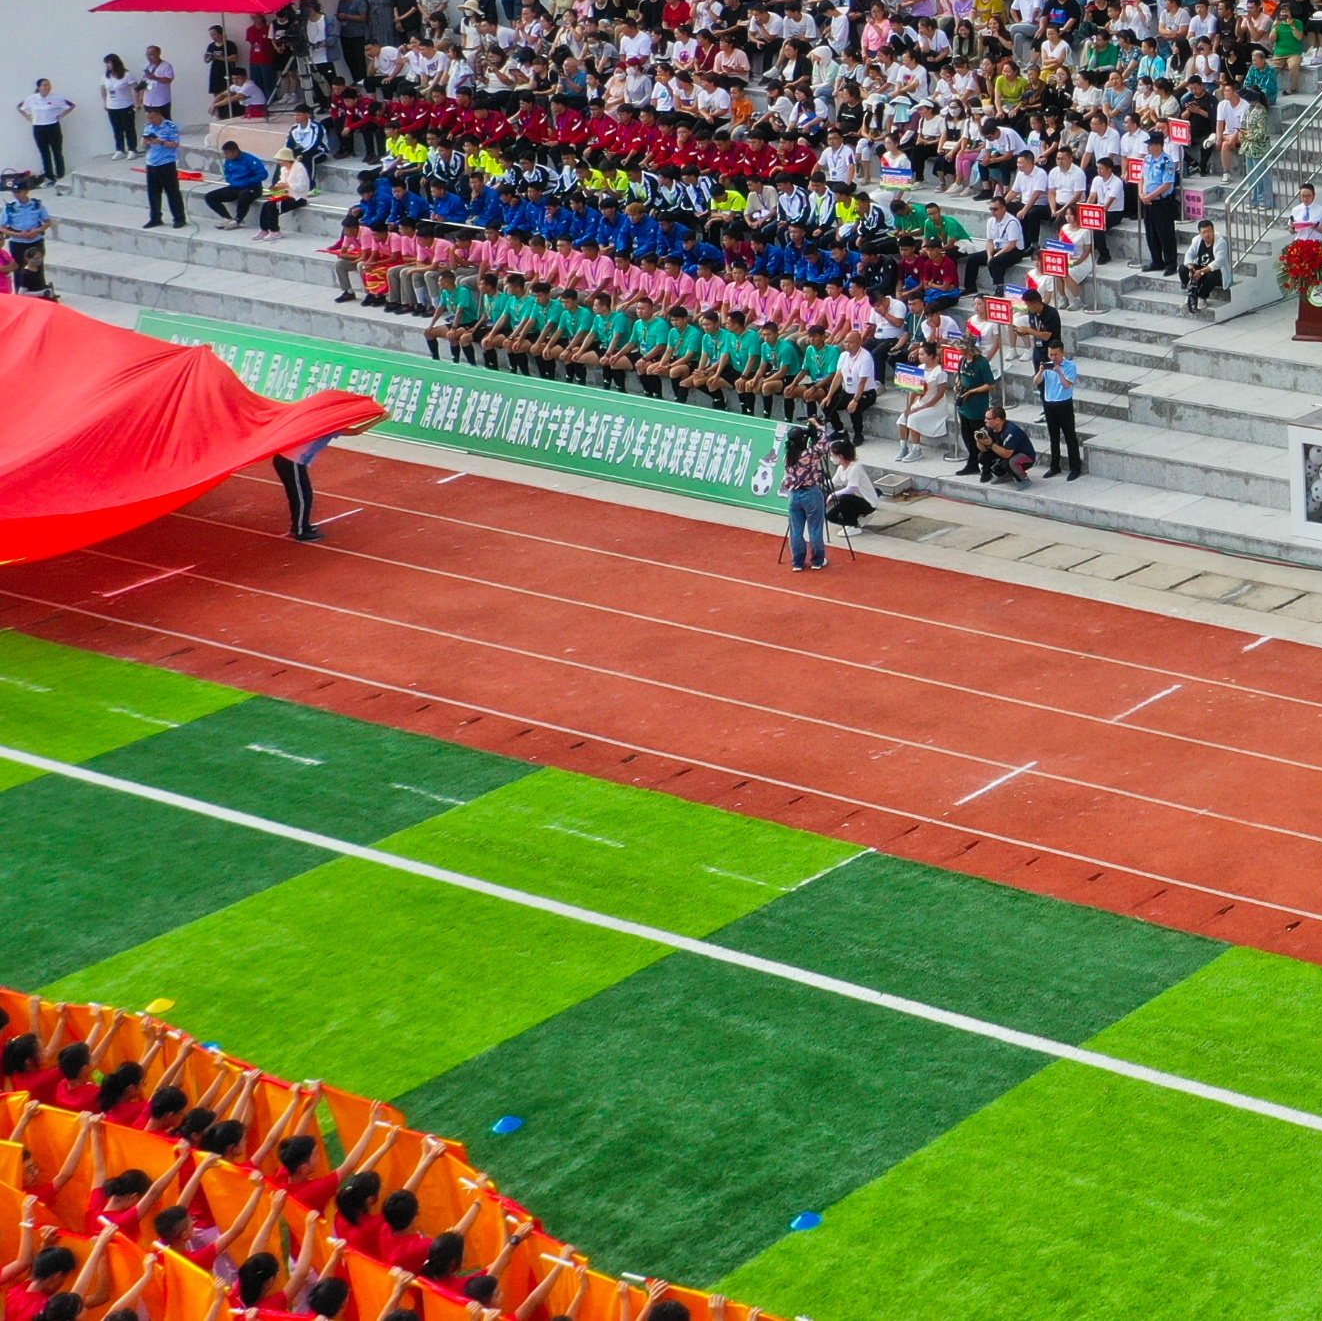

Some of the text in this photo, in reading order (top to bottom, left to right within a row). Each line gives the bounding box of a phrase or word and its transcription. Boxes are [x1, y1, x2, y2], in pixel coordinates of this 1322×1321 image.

[420, 382, 464, 433] 清涧县
[458, 384, 754, 488] 祝贺第八届陕甘宁革命老区青少年足球联赛圆满成功
